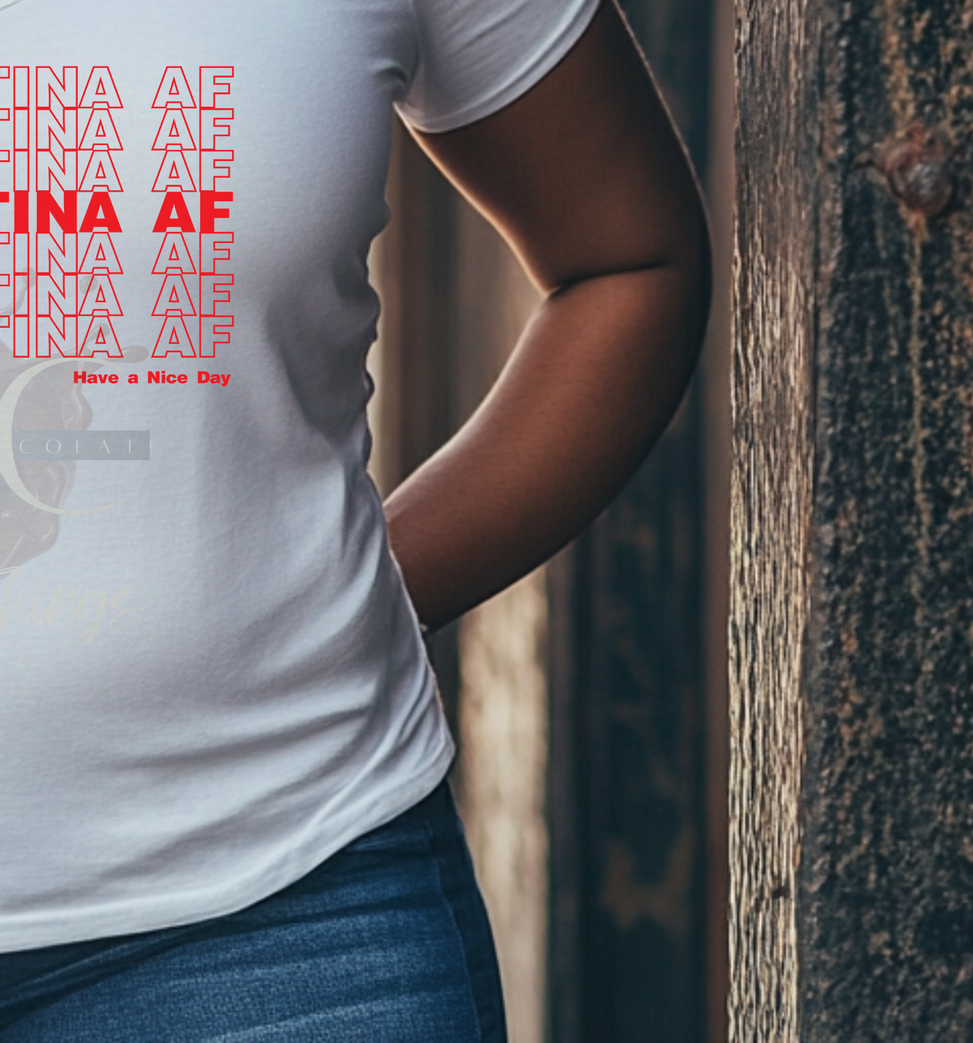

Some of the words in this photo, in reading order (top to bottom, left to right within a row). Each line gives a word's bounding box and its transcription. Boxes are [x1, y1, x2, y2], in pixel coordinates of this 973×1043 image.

[151, 65, 234, 109] AF
[151, 107, 234, 151] AF
[151, 149, 234, 192] AF
[151, 191, 234, 233] AF
[151, 232, 234, 275] AF
[151, 273, 234, 317] AF
[151, 314, 234, 358] AF
[73, 370, 119, 384] Have
[127, 373, 139, 384] a
[147, 370, 188, 384] Nice
[197, 370, 231, 387] Day
